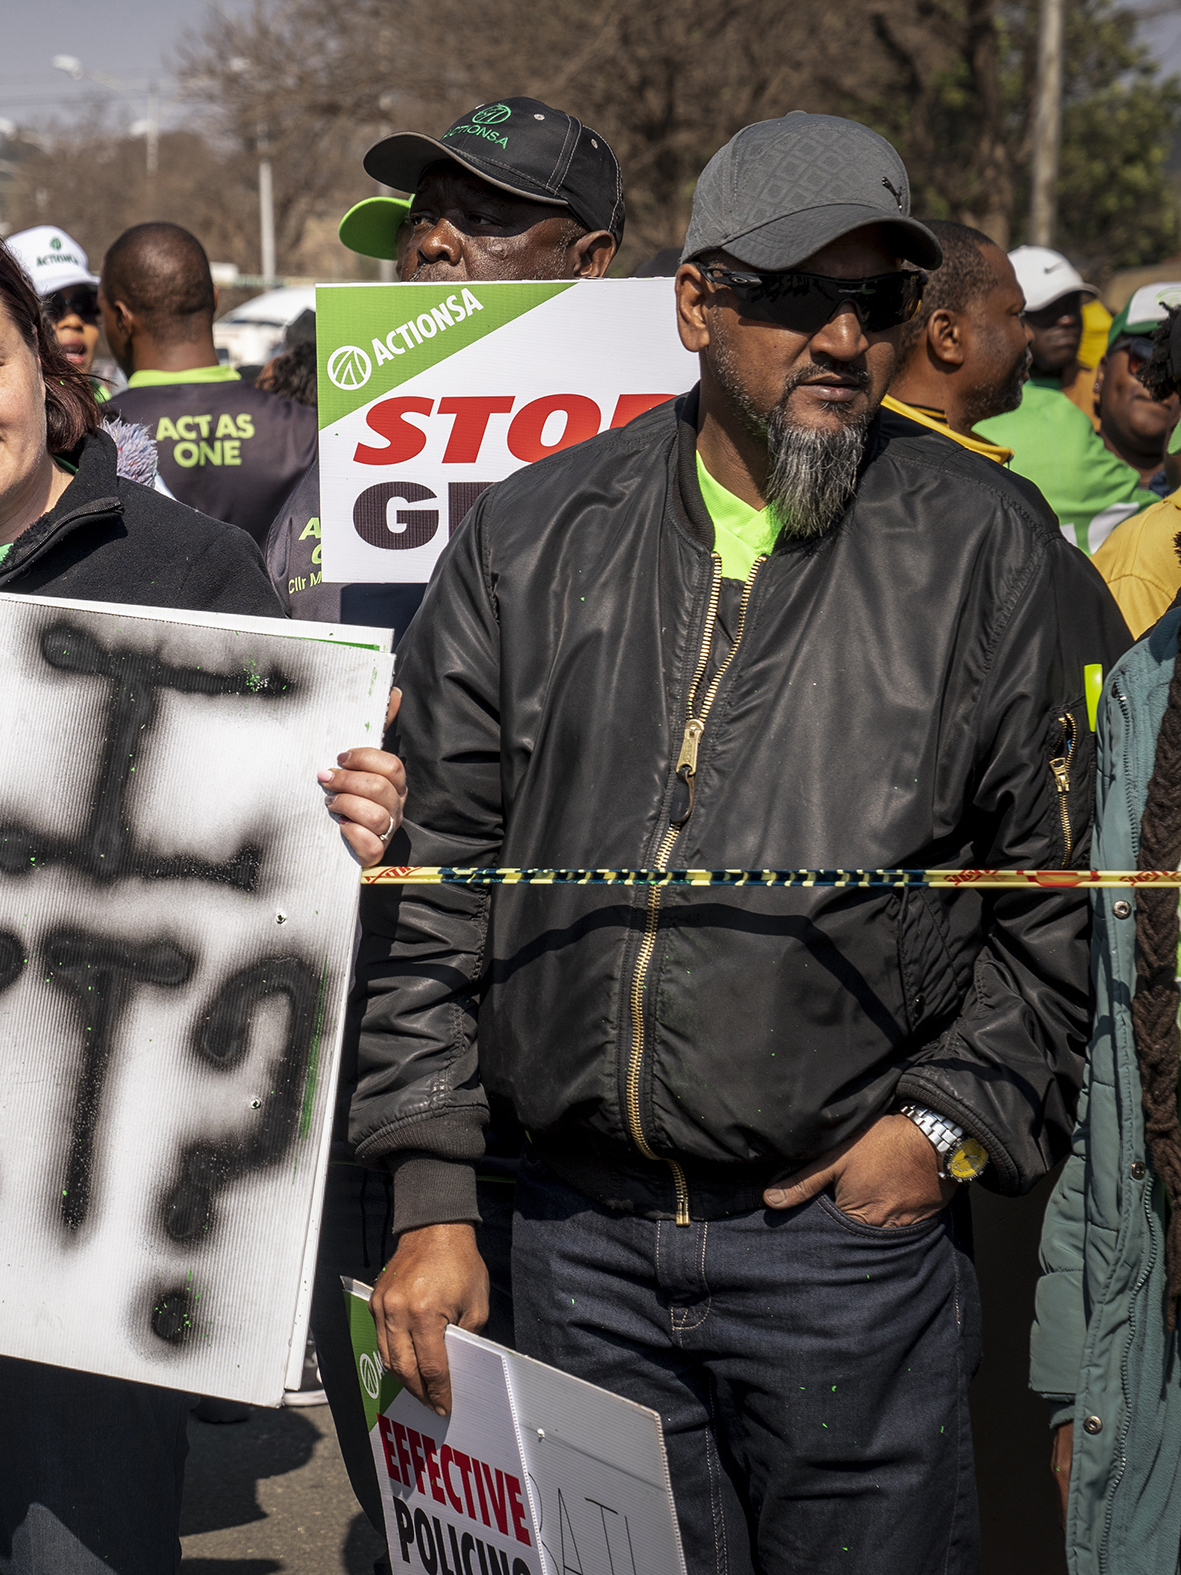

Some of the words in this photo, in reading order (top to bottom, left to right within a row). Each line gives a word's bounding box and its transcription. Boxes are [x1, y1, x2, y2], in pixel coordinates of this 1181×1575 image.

[371, 288, 484, 367] ACTIONSA
[156, 414, 212, 441] ACT
[215, 413, 255, 439] AS
[173, 440, 242, 468] ONE
[376, 1412, 532, 1547] EFFECTIVE
